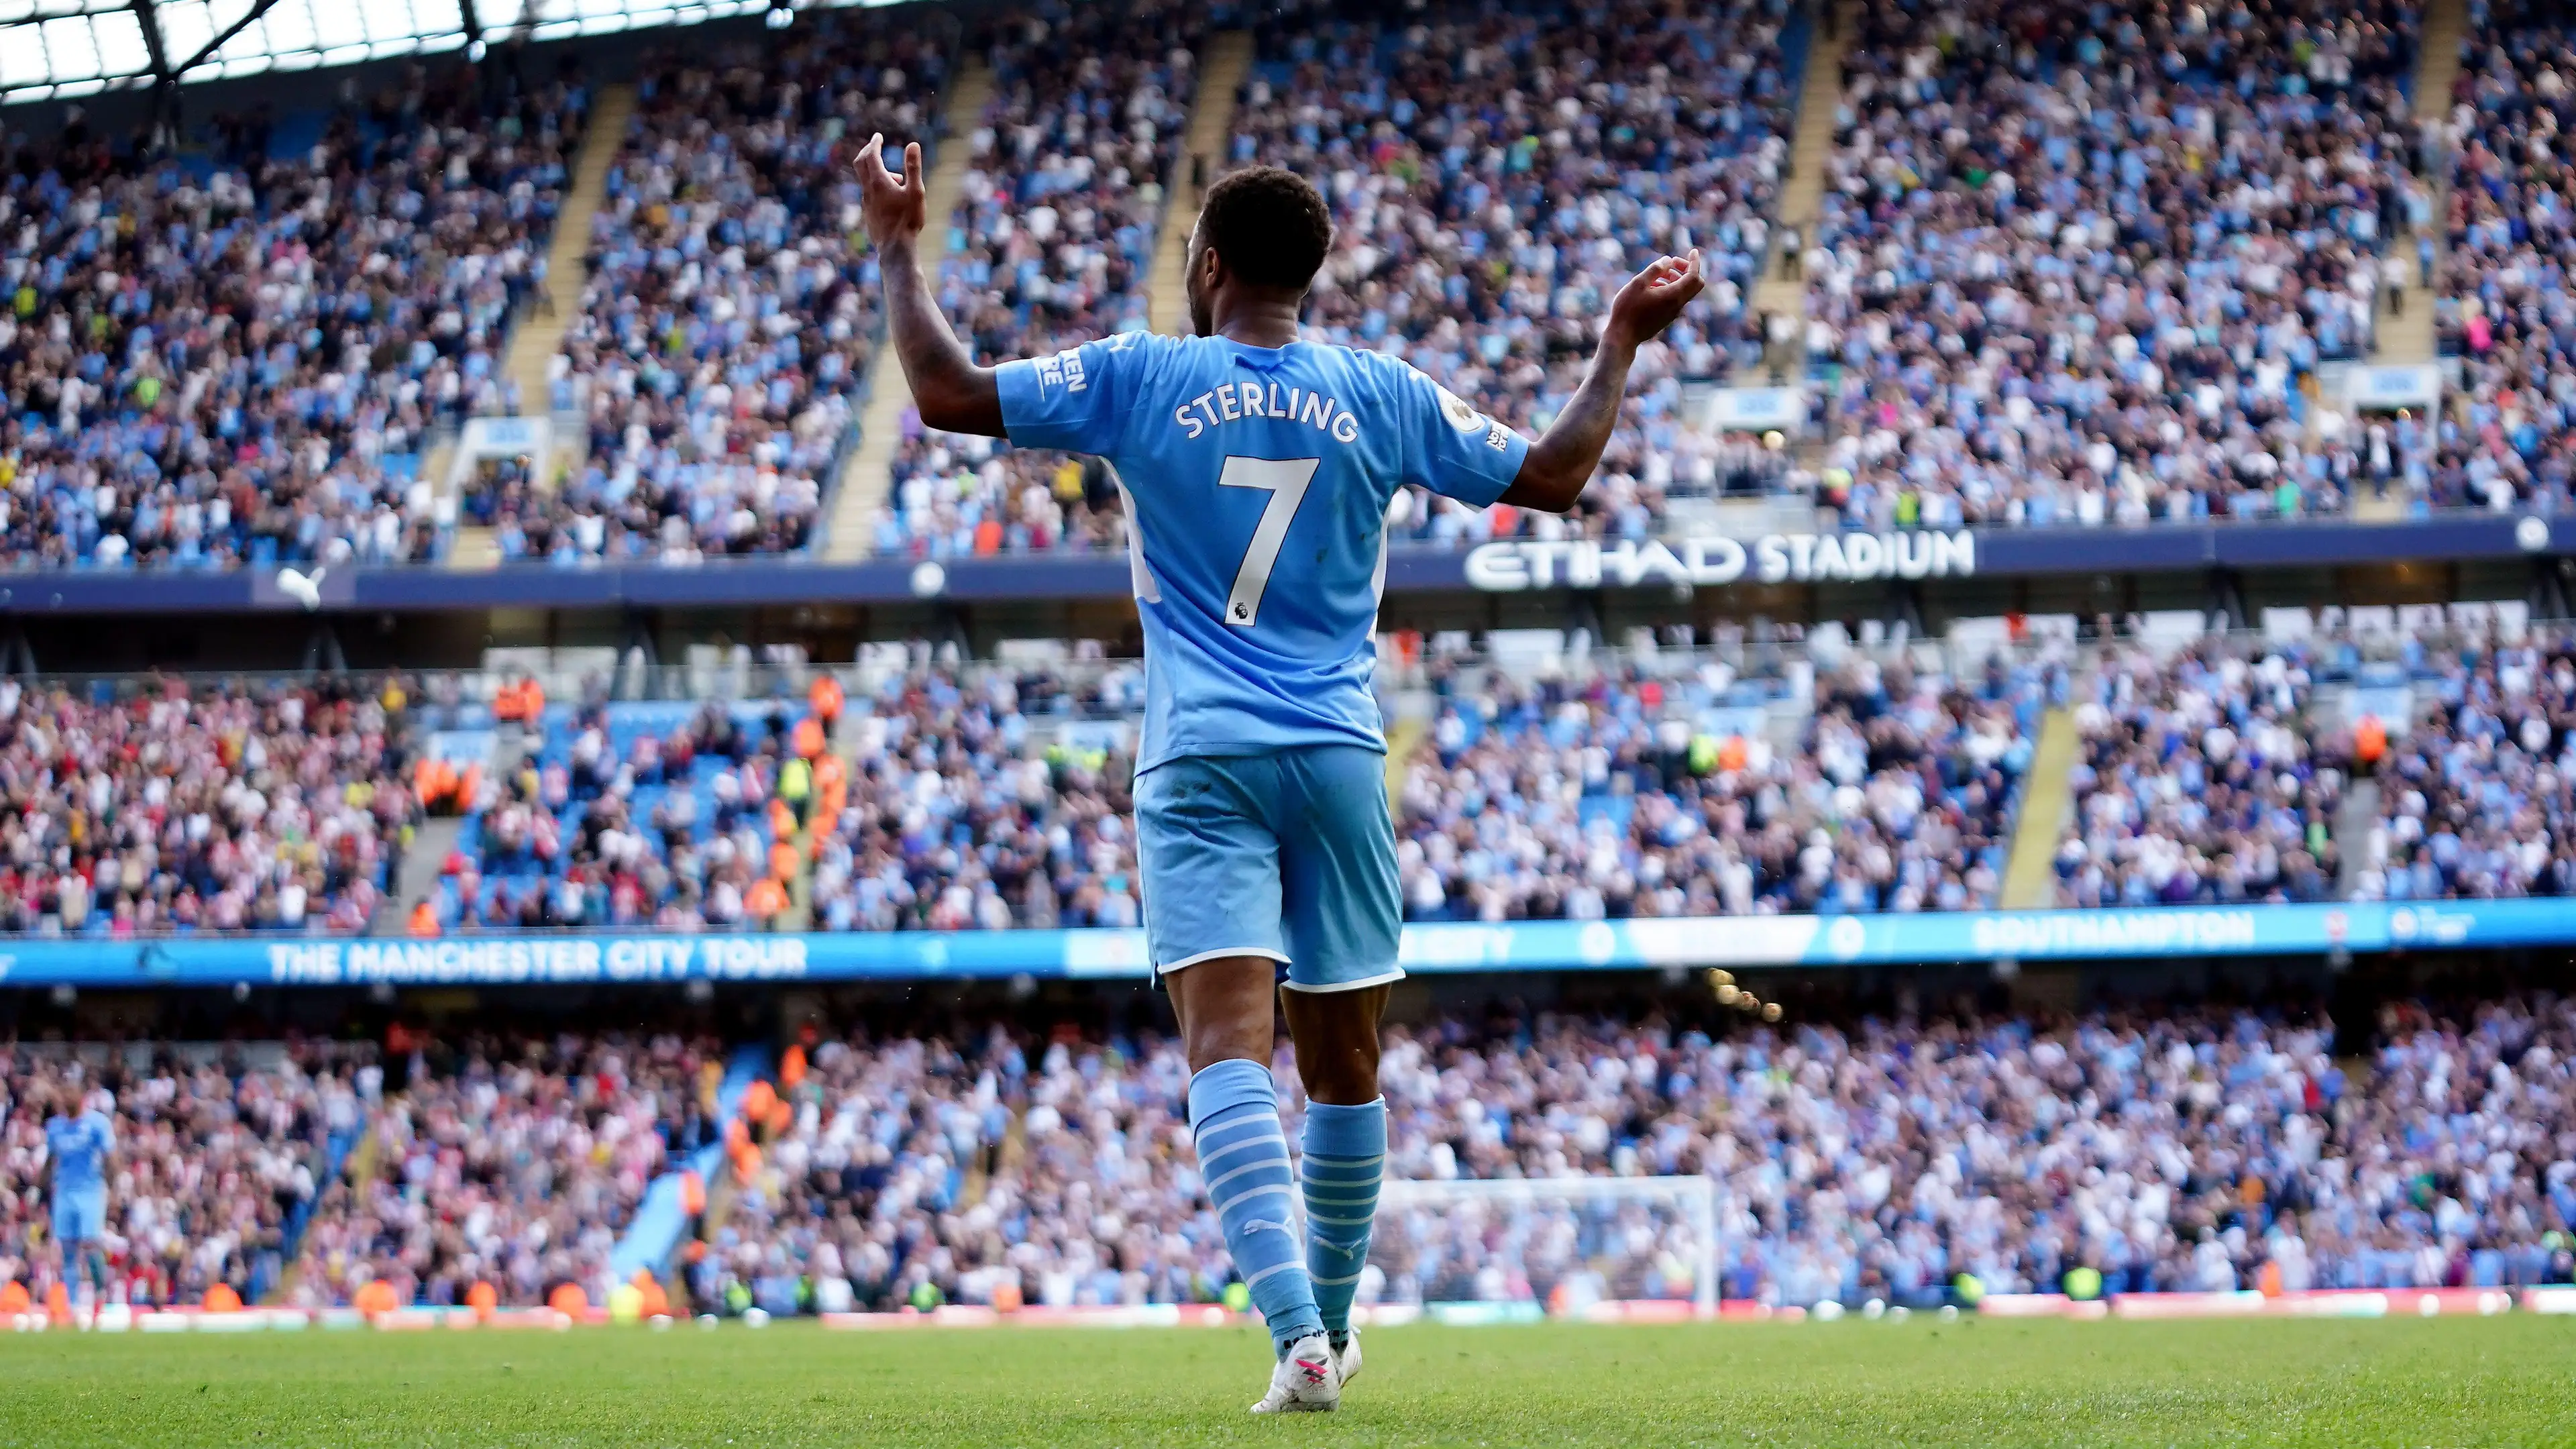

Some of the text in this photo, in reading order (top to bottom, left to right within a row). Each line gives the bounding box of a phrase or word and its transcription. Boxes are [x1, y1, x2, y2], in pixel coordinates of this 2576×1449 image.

[1176, 382, 1358, 443] STERLING
[1219, 455, 1321, 627] 7
[1465, 529, 1975, 591] ETIHAD STADIUM
[270, 938, 808, 981] THE MANCHESTER CITY TOUR
[1972, 911, 2255, 955] SOUTHAMPTON
